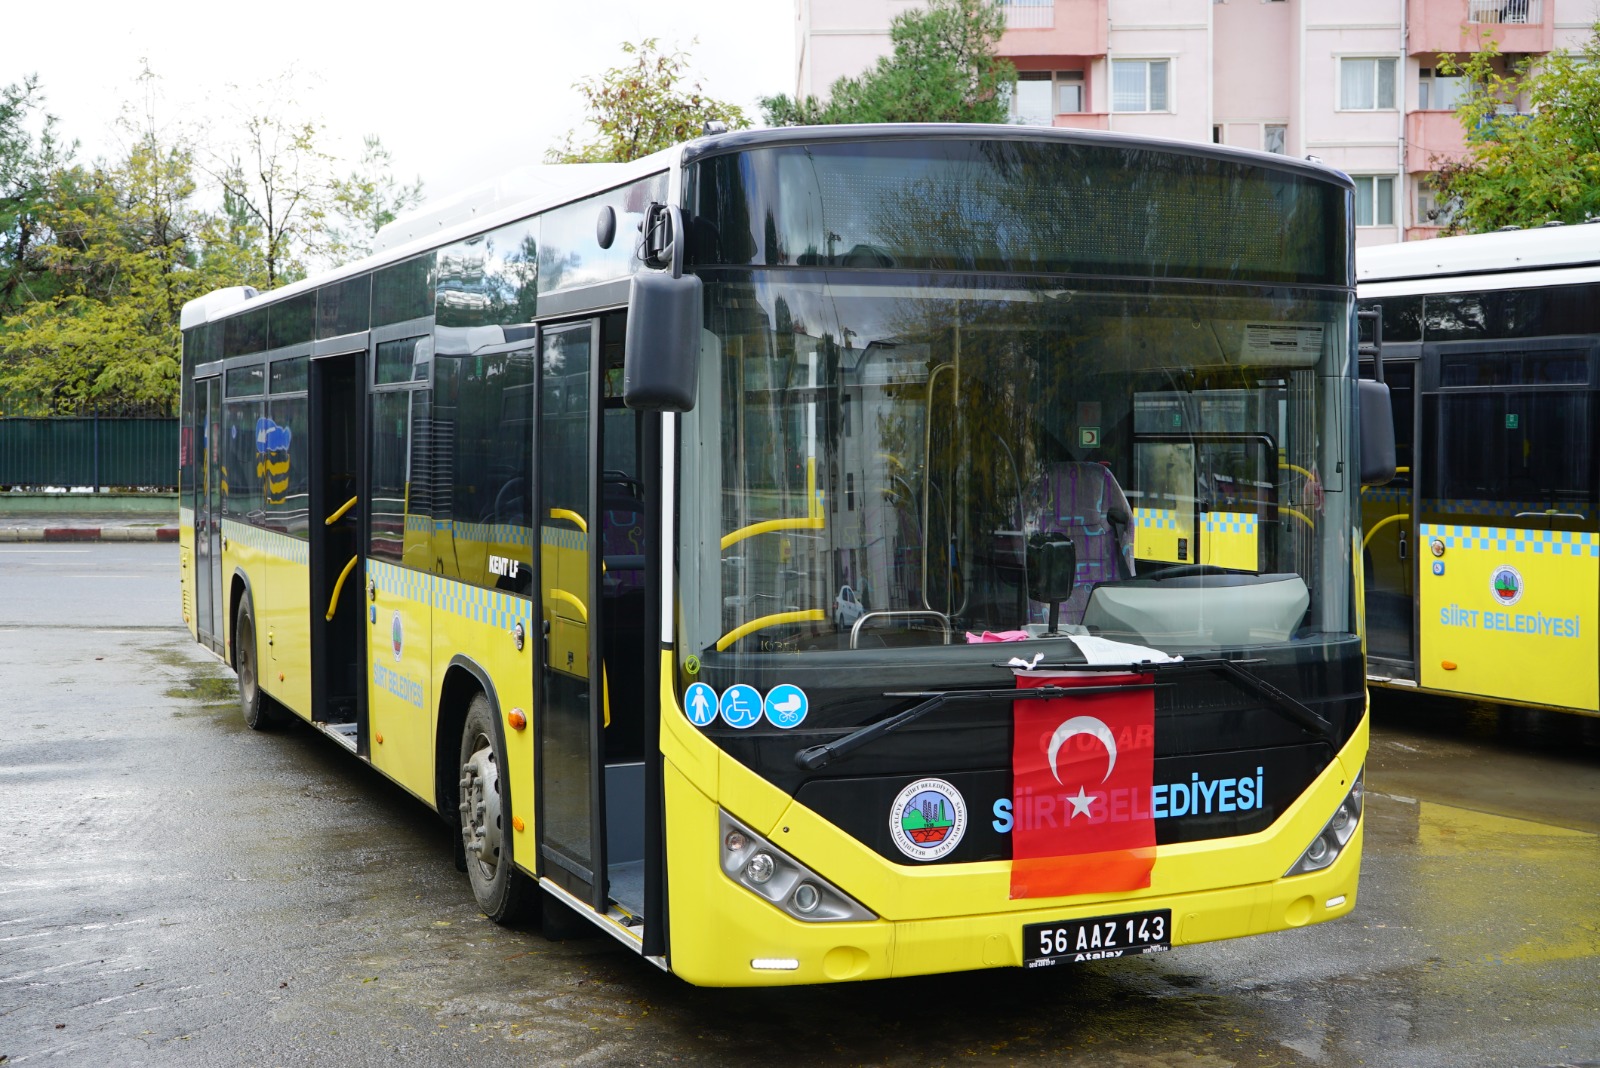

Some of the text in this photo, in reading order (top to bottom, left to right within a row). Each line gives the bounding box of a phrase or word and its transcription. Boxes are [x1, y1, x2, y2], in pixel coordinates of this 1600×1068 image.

[489, 555, 519, 579] KENT LF
[1440, 603, 1580, 638] SİİRT BELEDİYESİ
[1039, 724, 1153, 754] OTOKAR
[992, 766, 1264, 834] SİİRT BELEDİYESİ
[1040, 917, 1164, 955] 56 AAZ 143
[1074, 950, 1124, 962] Atalay
